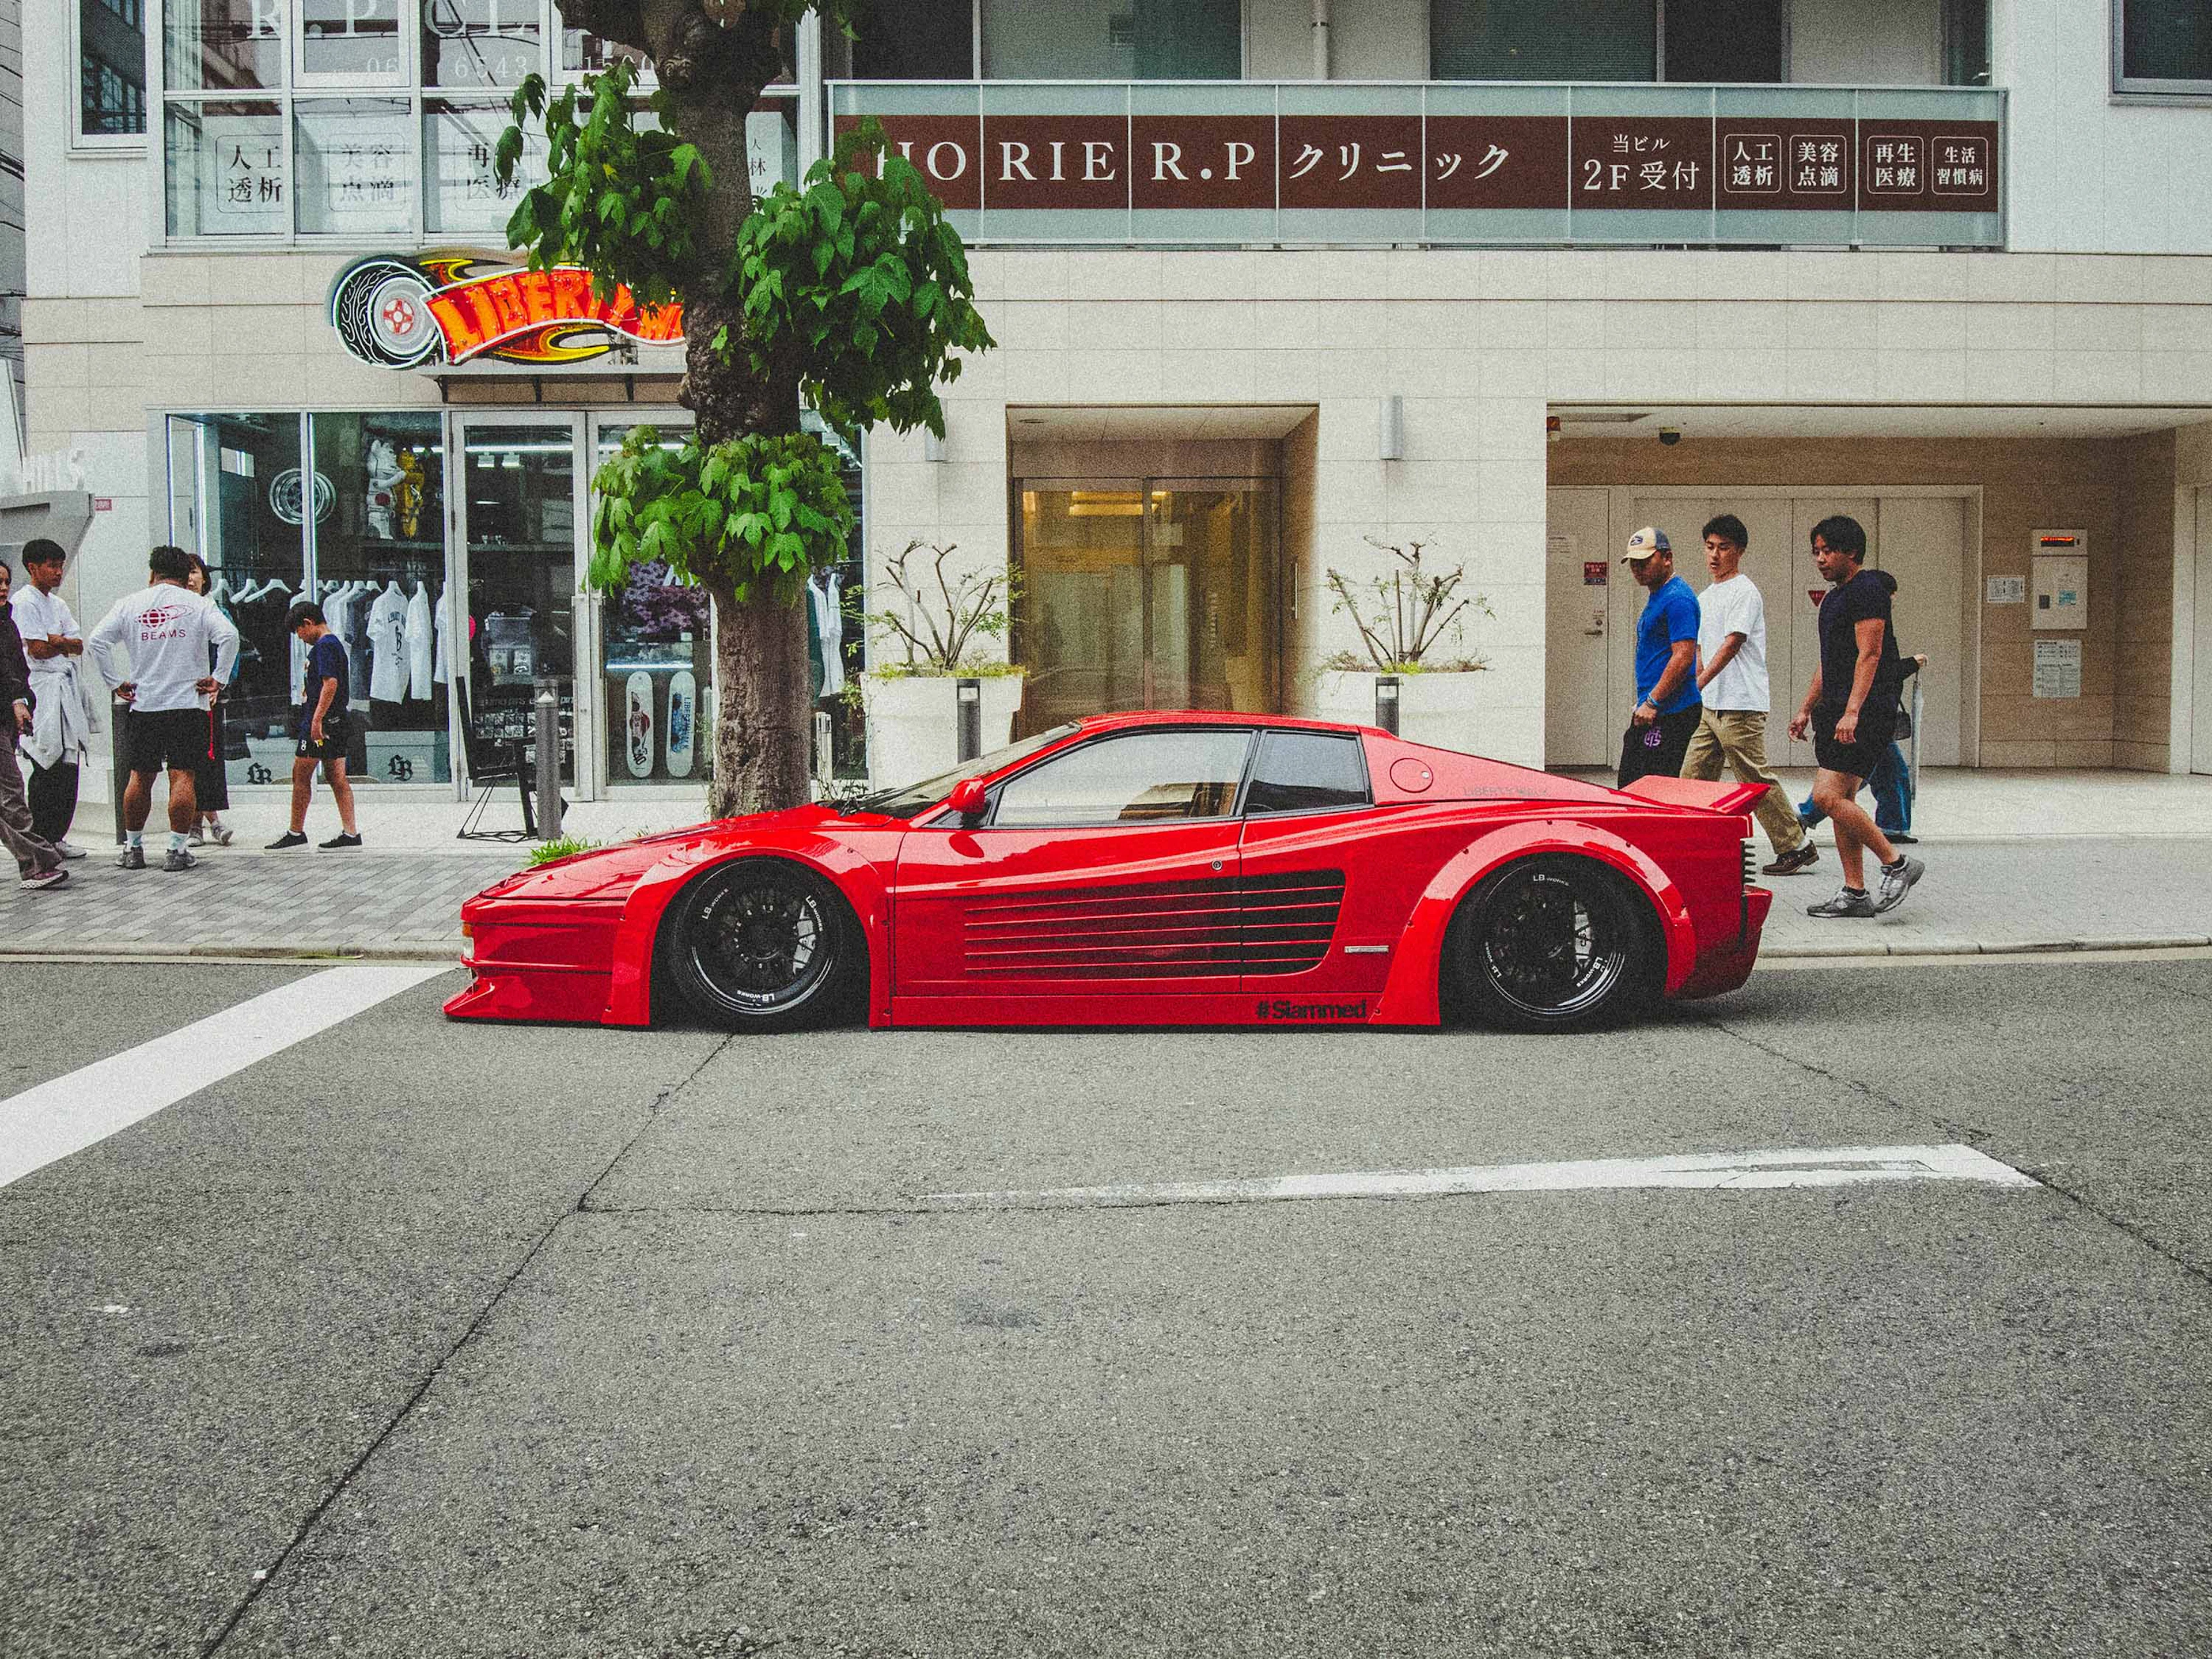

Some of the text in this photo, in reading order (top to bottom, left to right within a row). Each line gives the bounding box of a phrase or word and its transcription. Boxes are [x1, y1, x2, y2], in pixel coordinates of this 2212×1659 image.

[1613, 134, 1670, 153] 当ビル
[1733, 141, 1774, 161] 人工
[1798, 142, 1839, 162] 美容
[1875, 143, 1916, 164] 再生
[230, 145, 282, 170] 人工
[1151, 142, 1255, 180] R.P
[1289, 143, 1509, 181] クリニック
[1944, 146, 1976, 164] 生活
[1584, 159, 1699, 190] 2F受付
[1732, 165, 1774, 186] 透析
[1797, 166, 1839, 187] 点滴
[1875, 166, 1916, 187] 医療
[1937, 168, 1983, 186] 習慣病
[228, 176, 282, 203] 透析
[141, 629, 186, 641] BEAMS
[1256, 999, 1367, 1019] #Slammed
